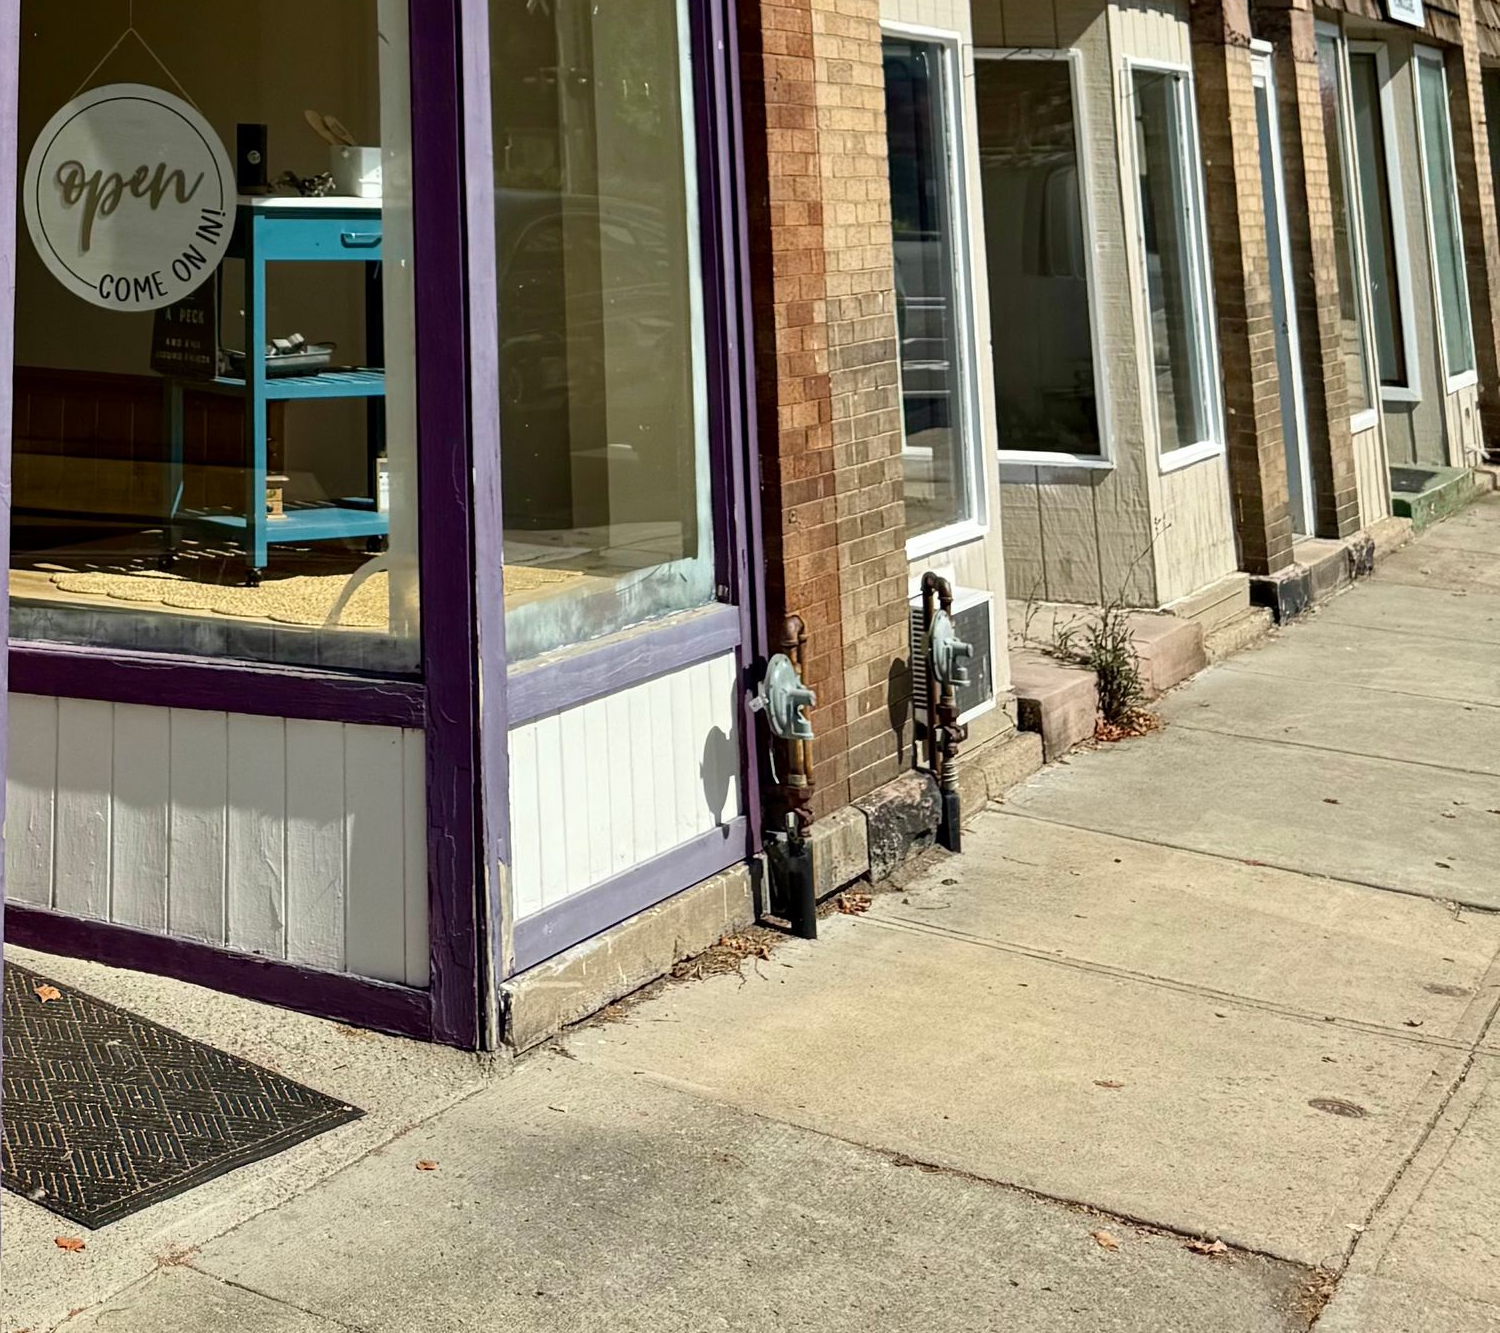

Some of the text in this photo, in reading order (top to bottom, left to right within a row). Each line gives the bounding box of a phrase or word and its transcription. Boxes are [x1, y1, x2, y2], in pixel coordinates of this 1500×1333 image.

[56, 160, 204, 254] open
[99, 207, 227, 303] COME ON IN!
[179, 308, 205, 324] PECK
